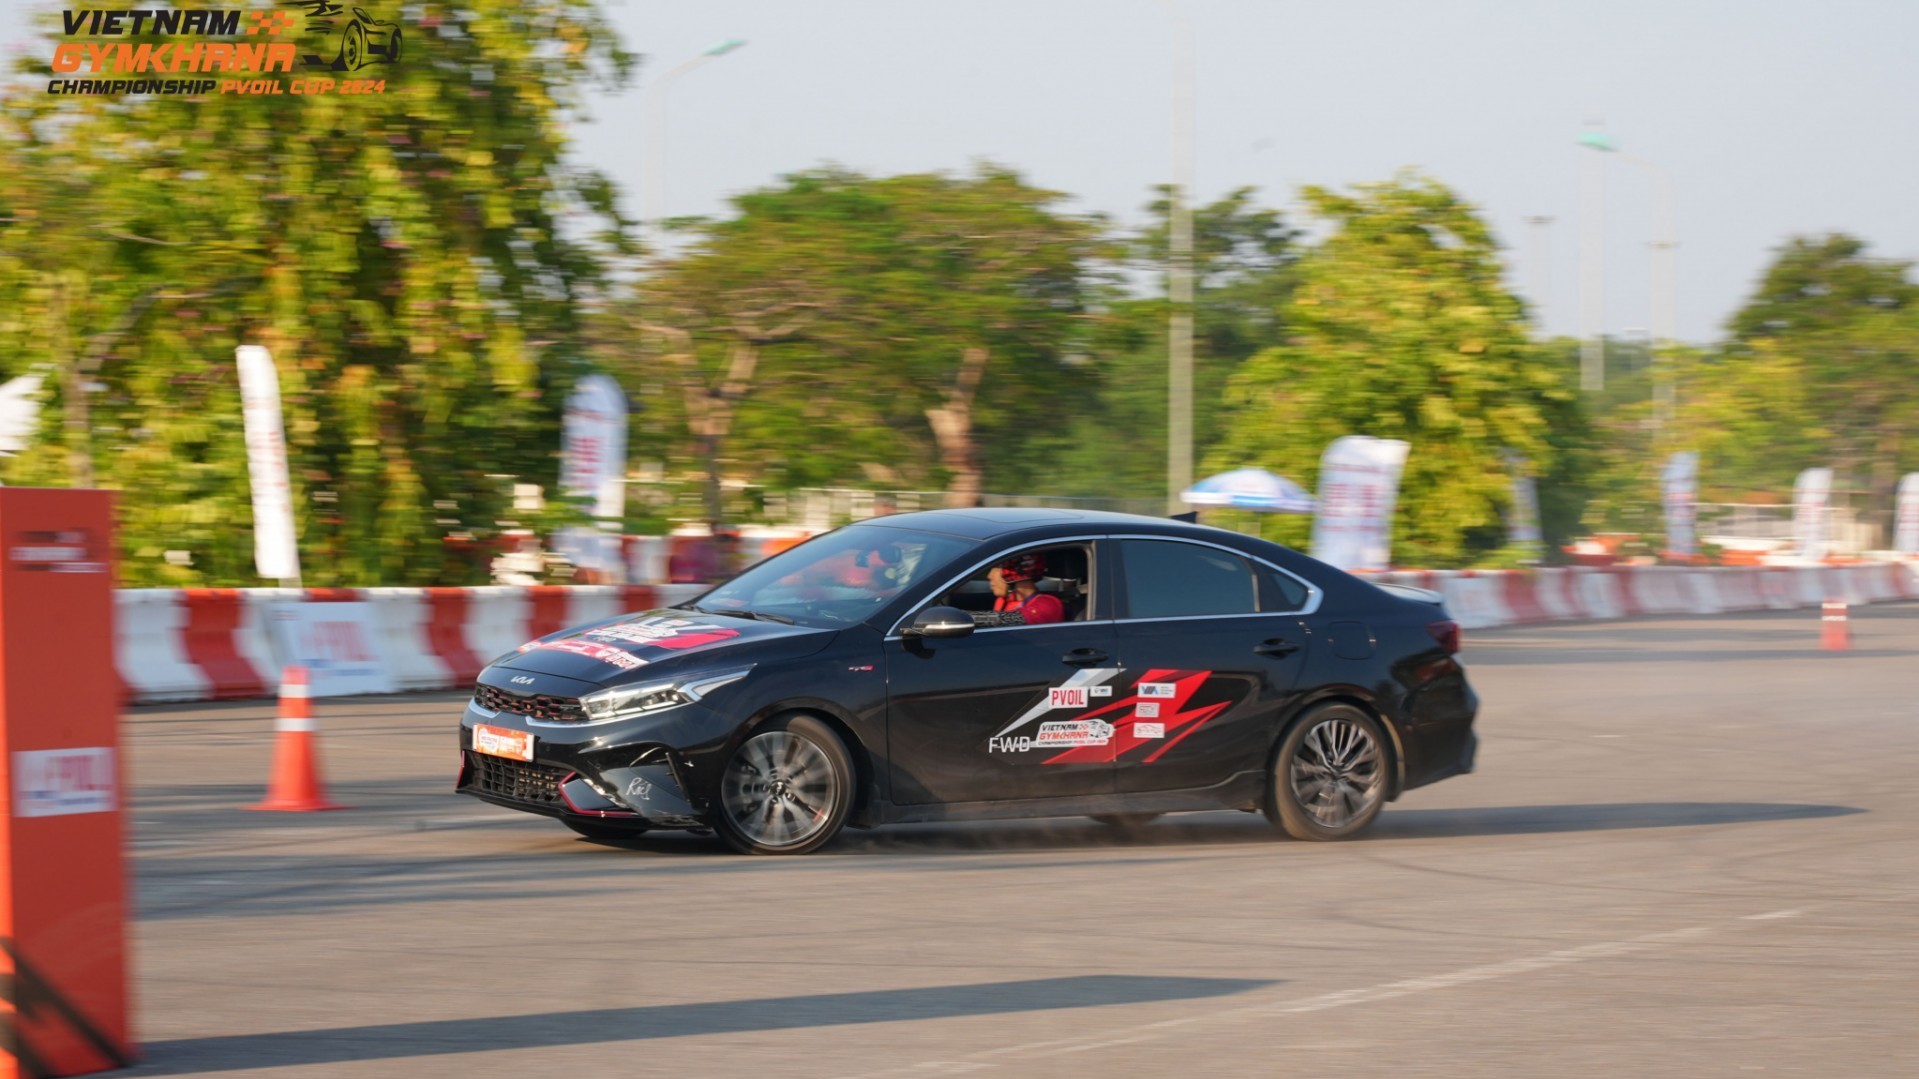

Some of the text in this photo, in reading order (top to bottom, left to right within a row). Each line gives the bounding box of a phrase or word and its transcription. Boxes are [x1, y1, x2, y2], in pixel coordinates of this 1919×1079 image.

[1052, 689, 1084, 706] PVOIL
[1039, 731, 1088, 740] GYMKHANA
[988, 736, 1031, 753] FWD
